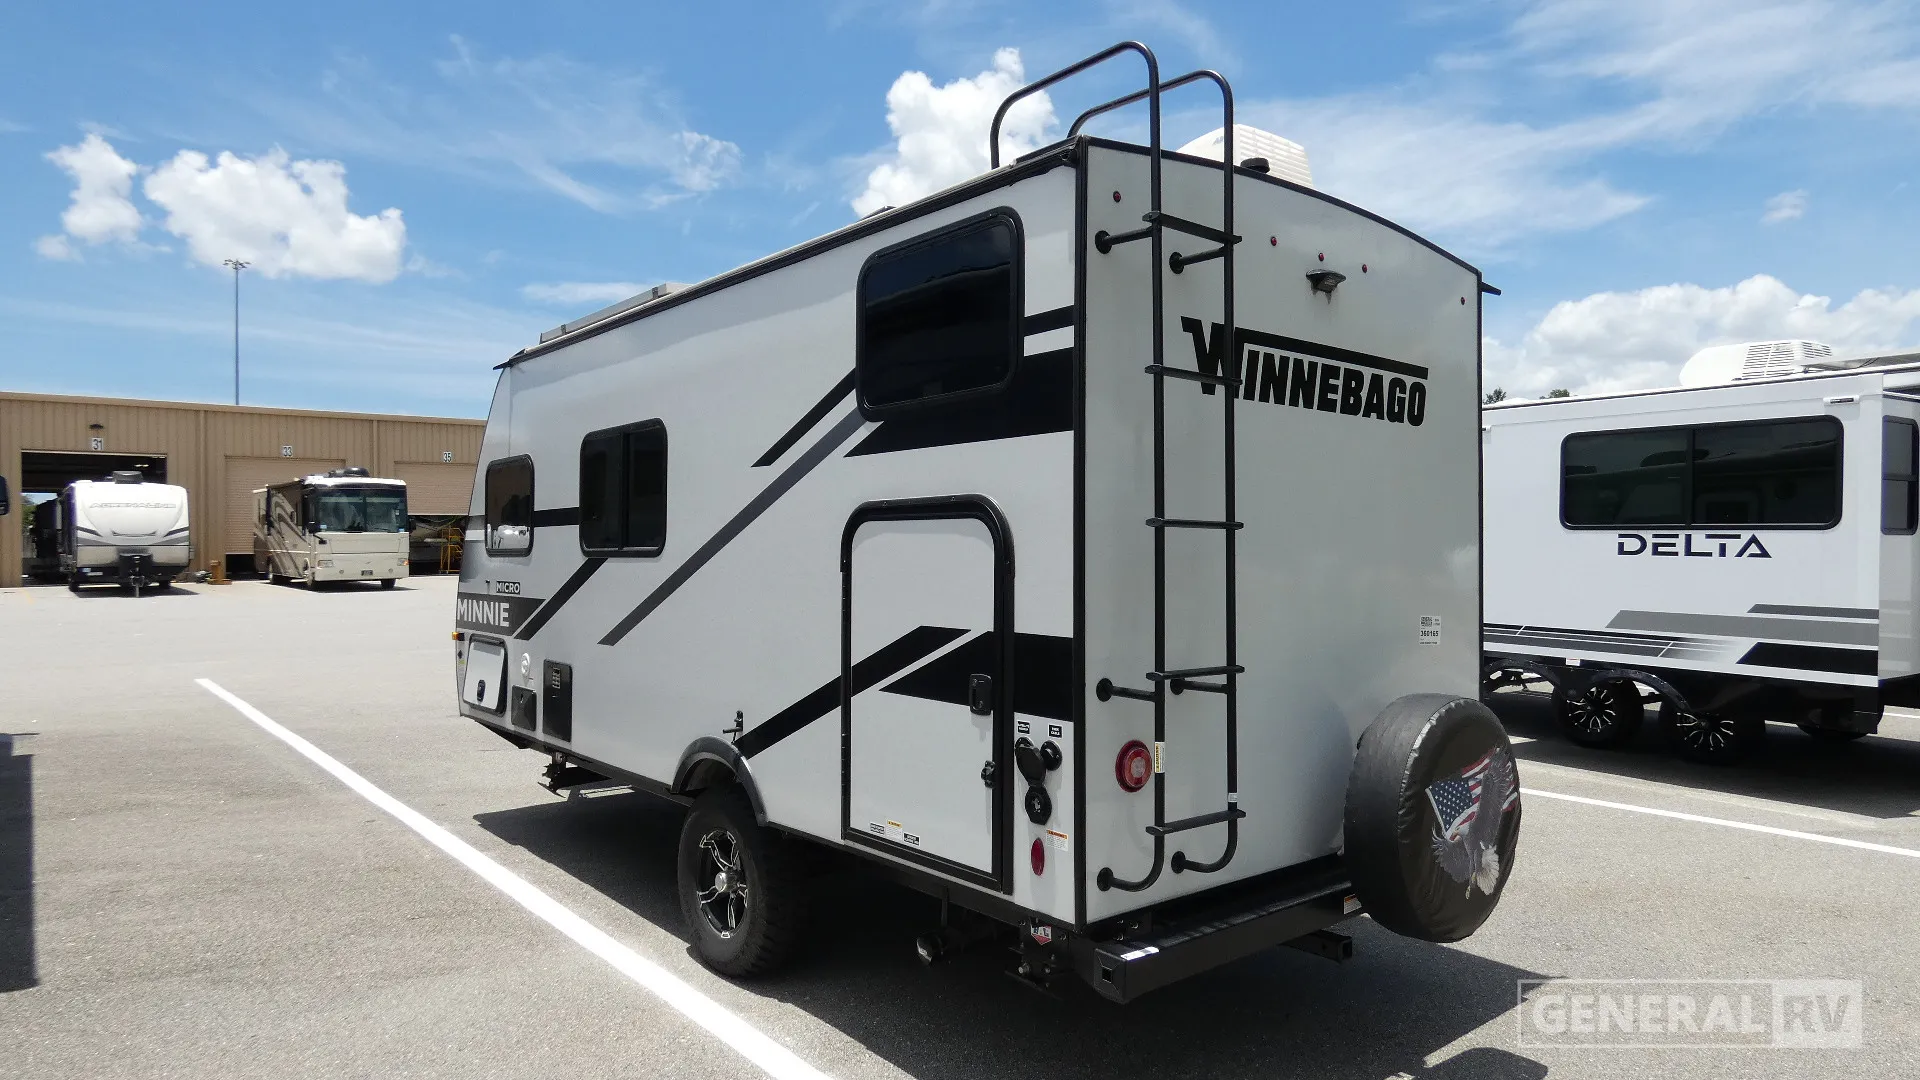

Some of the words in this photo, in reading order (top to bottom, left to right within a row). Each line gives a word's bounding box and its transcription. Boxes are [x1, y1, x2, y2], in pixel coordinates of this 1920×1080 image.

[1181, 316, 1428, 427] WINNEBAGO
[92, 438, 103, 450] 31
[283, 446, 293, 457] 33
[443, 452, 452, 463] 35
[1617, 533, 1773, 559] DELTA
[496, 581, 520, 593] MICRO
[457, 598, 510, 627] MINNIE
